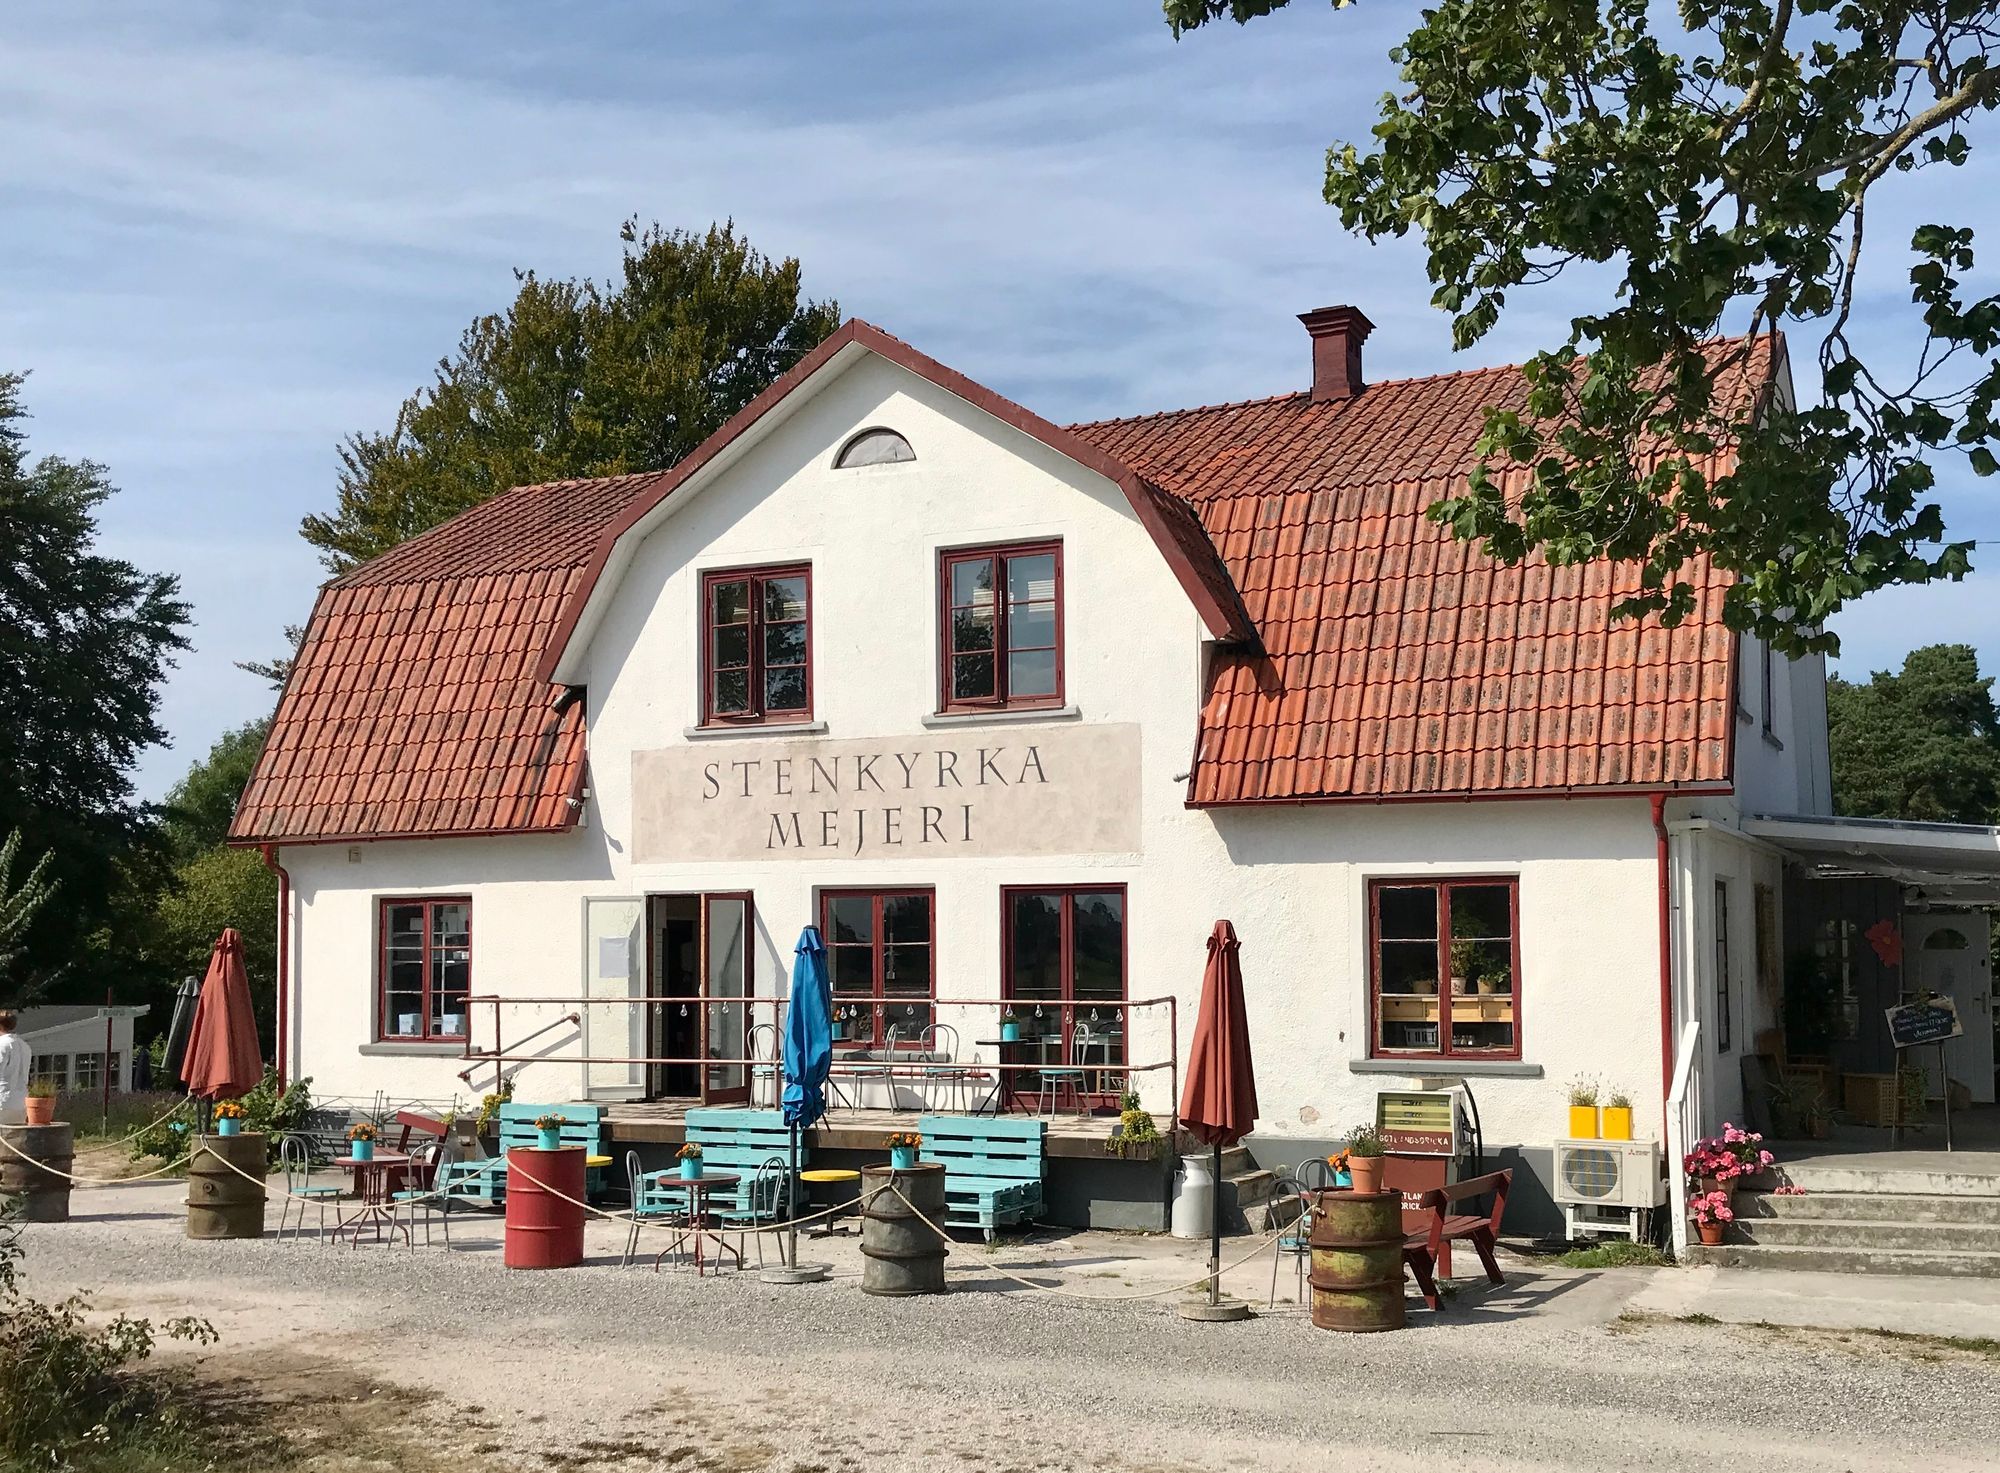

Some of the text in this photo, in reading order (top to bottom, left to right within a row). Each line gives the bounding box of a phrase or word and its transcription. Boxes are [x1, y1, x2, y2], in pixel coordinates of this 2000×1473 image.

[703, 746, 1050, 803] STENKYRKA
[765, 804, 974, 857] MEJERI
[1401, 1191, 1423, 1201] TLAN
